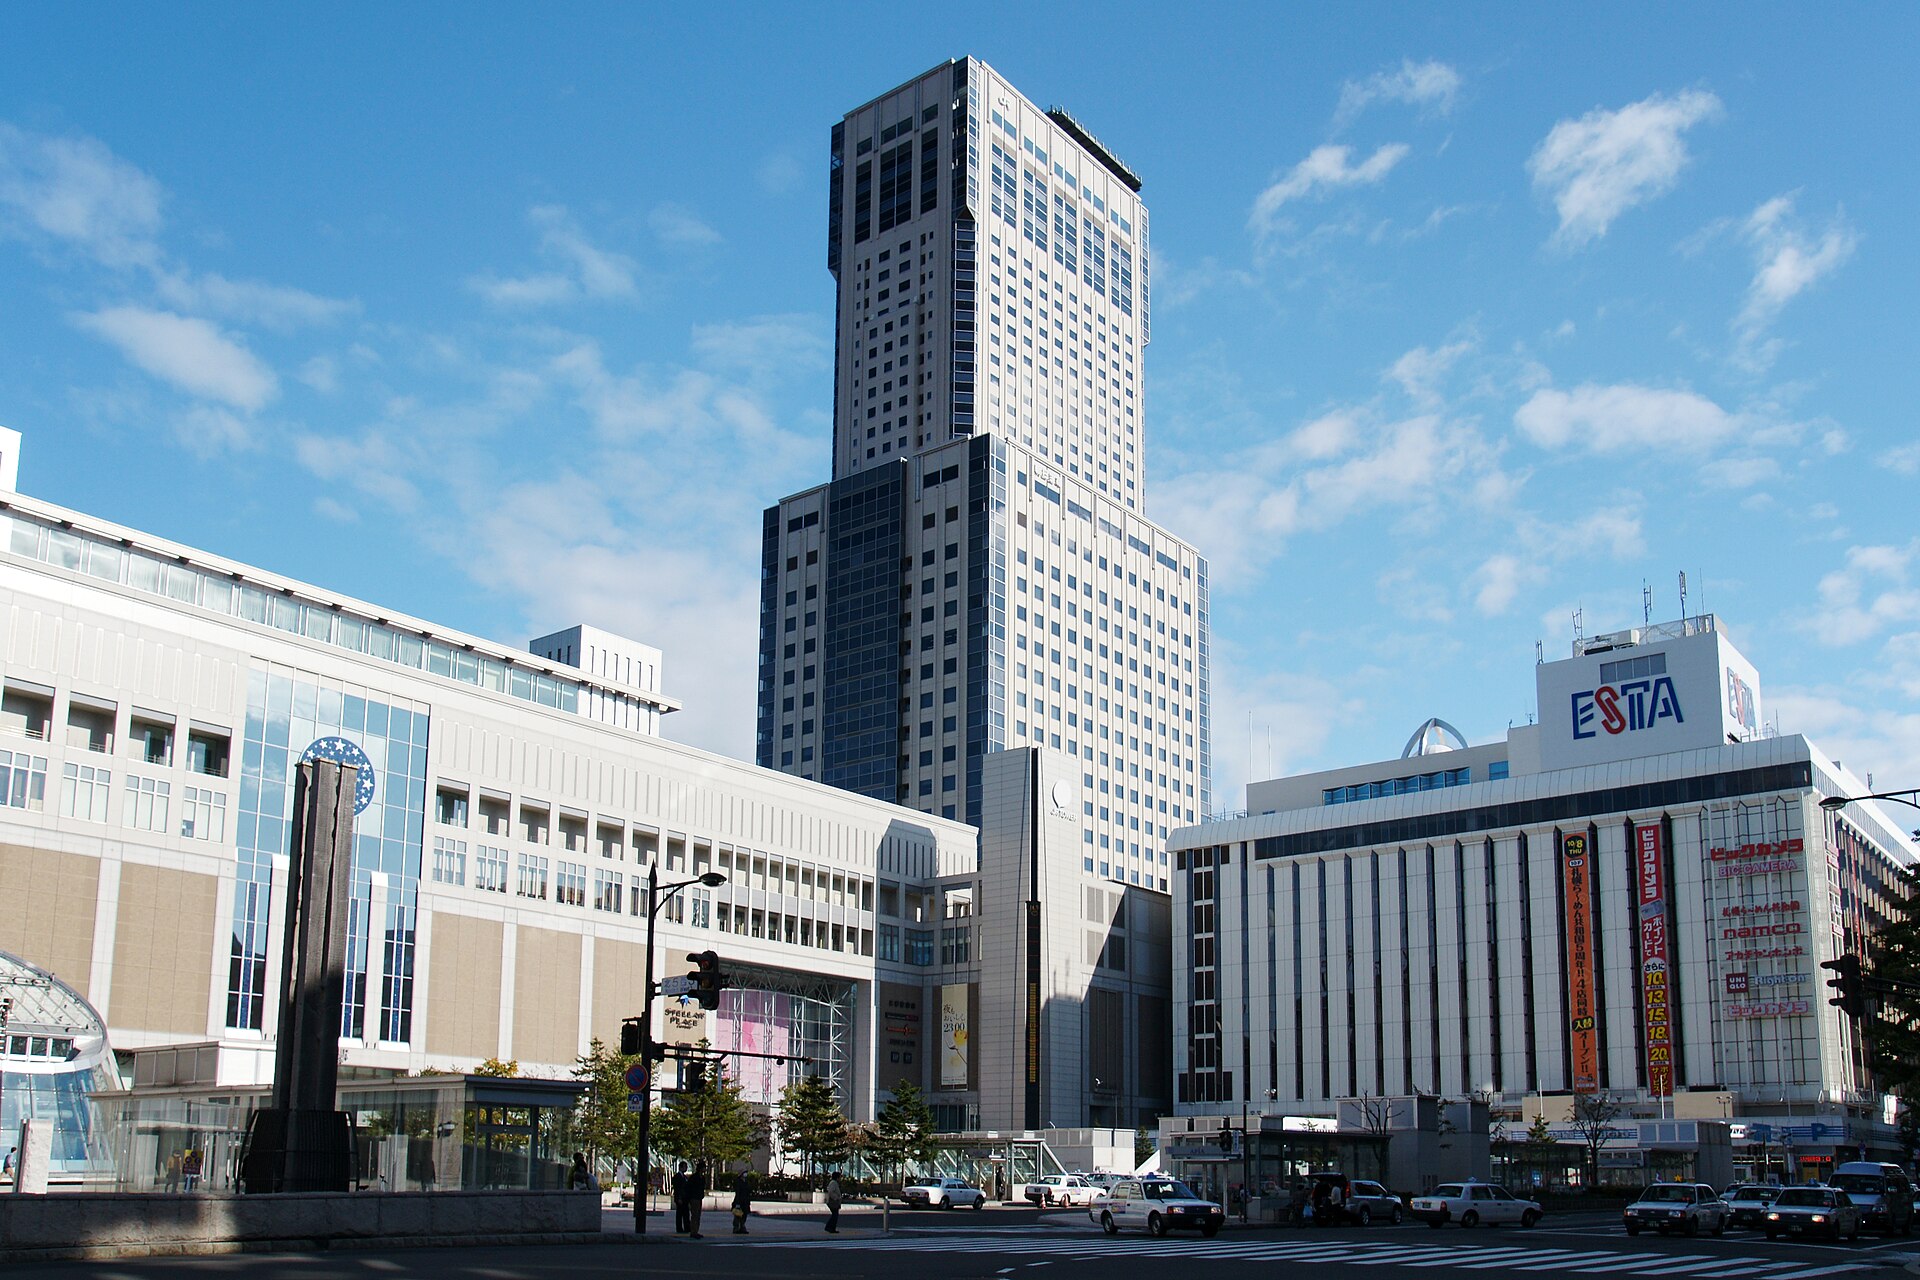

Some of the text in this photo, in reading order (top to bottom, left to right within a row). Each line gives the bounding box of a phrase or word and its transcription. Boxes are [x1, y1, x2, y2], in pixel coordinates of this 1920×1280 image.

[1571, 677, 1684, 740] ESTA
[1726, 666, 1757, 737] ESTA
[1710, 838, 1804, 862] ビックカメラ
[1642, 829, 1658, 899] ビックカメラ
[1719, 859, 1798, 877] BIC CAMERA
[1723, 922, 1801, 940] namco
[1725, 946, 1803, 961] アカチャンホンポ
[1644, 961, 1666, 971] さらに
[664, 1008, 705, 1020] STELLAR
[1727, 1000, 1809, 1017] ビックカメラ
[670, 1016, 698, 1026] PLACE
